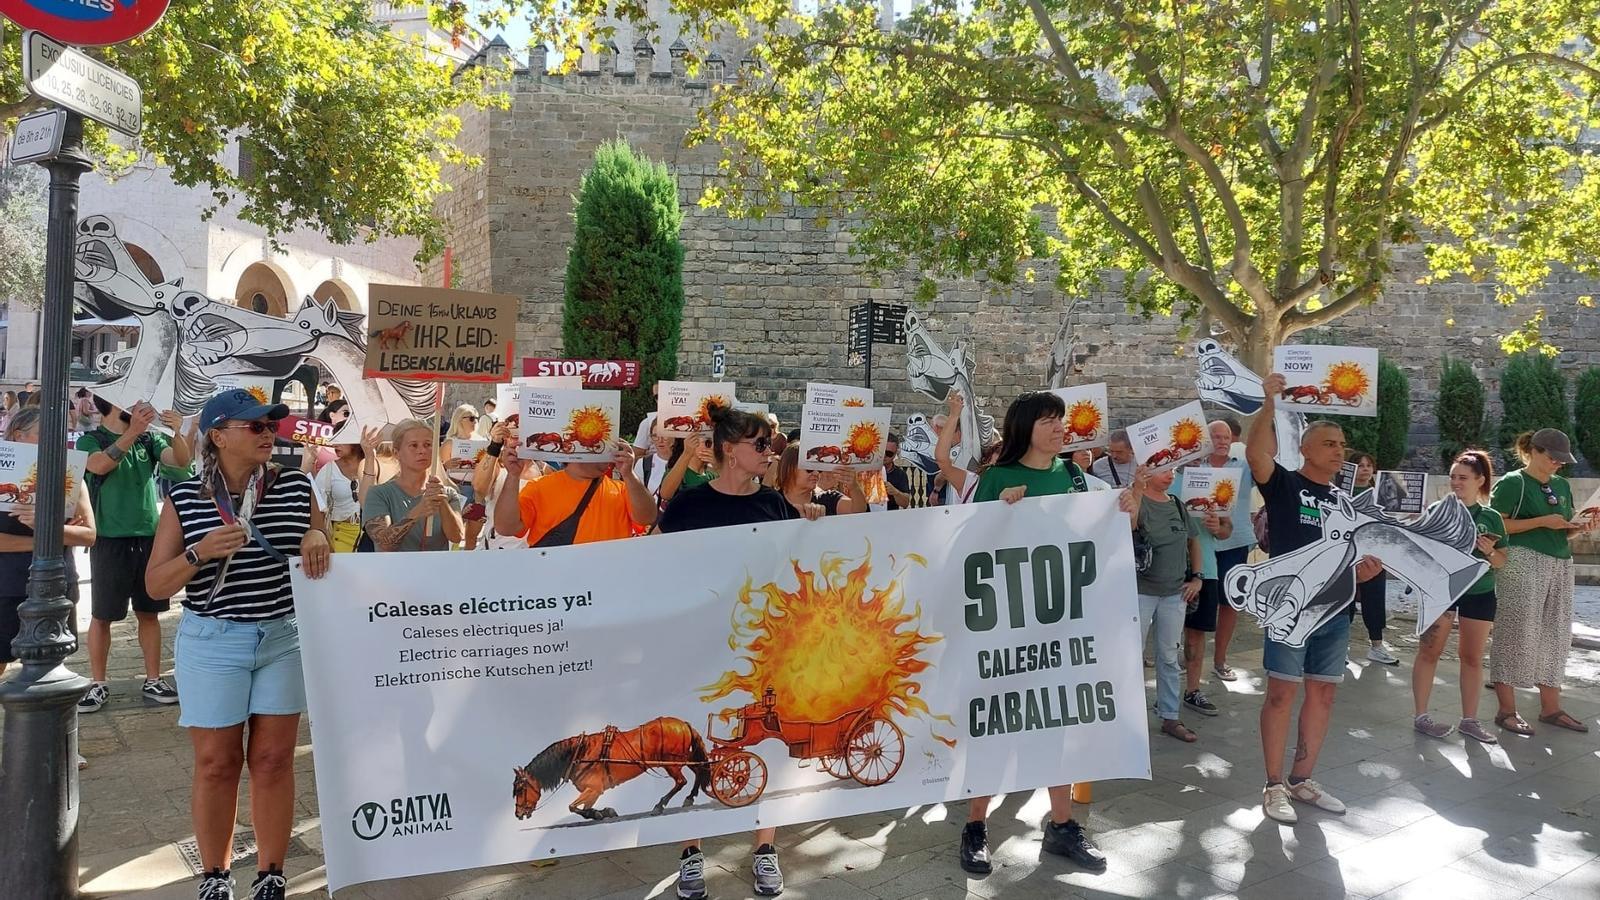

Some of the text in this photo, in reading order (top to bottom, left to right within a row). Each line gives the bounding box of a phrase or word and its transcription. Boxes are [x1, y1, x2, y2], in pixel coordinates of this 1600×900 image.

[41, 43, 85, 77] EXCLUSIU
[128, 112, 137, 127] 72
[17, 133, 25, 145] de
[377, 300, 423, 317] DEINE
[450, 303, 497, 320] URLAUB
[413, 324, 498, 348] IHR LEID:
[538, 361, 587, 376] STOP
[715, 356, 722, 373] P
[1284, 362, 1313, 370] NOW!
[529, 399, 555, 407] carriages
[531, 392, 553, 400] Electric
[671, 397, 687, 405] ¡YA!
[812, 397, 836, 405] JETZT!
[528, 407, 556, 417] NOW!
[809, 423, 841, 432] JETZT!
[1144, 433, 1158, 445] ¡YA!
[964, 540, 1097, 632] STOP
[368, 591, 592, 622] ¡Calesas eléctricas ya!
[402, 619, 564, 639] Caleses elèctriques ja!
[399, 641, 569, 663] Electric carriages now!
[978, 636, 1097, 680] CALESAS DE
[375, 659, 593, 687] Elektronische Kutschen jetzt!
[969, 681, 1116, 738] CABALLOS
[391, 793, 452, 825] SATYA
[392, 820, 454, 837] ANIMAL
